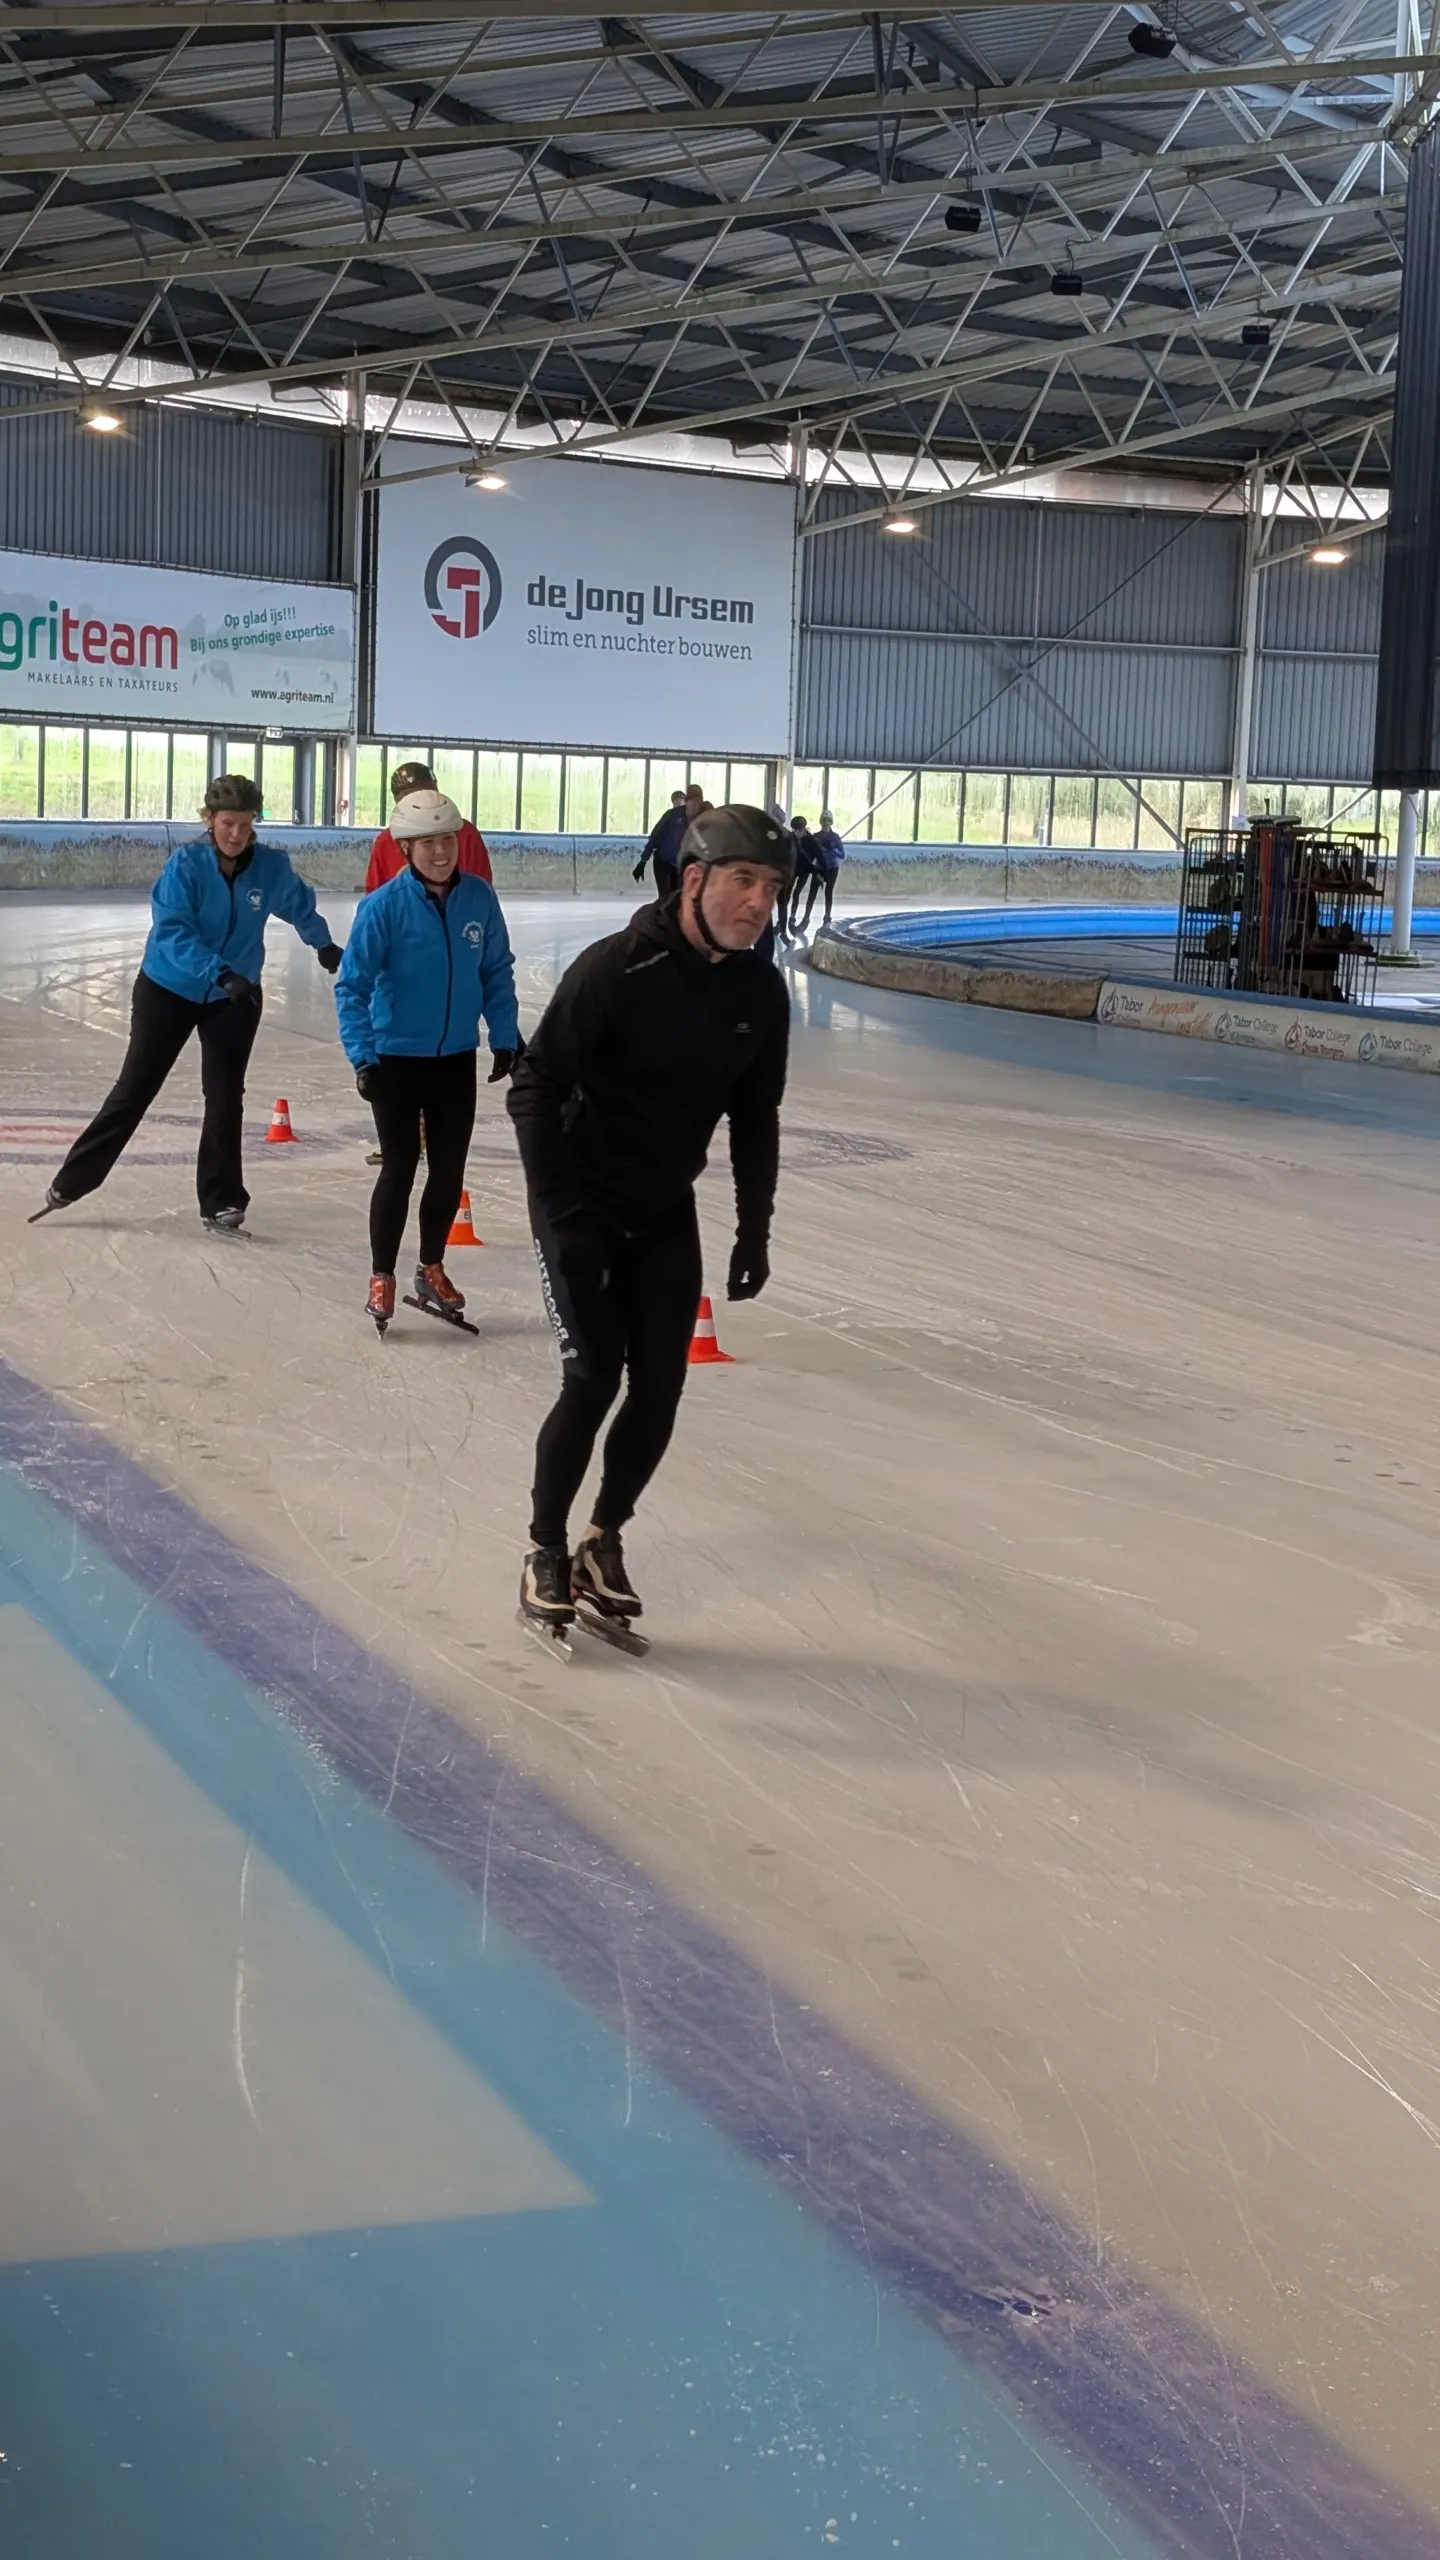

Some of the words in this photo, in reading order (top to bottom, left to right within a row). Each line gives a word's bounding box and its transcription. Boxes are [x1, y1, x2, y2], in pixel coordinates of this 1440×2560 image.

[653, 585, 754, 624] Ursem
[224, 613, 240, 630] Op
[243, 609, 267, 628] glad
[270, 606, 296, 625] ijs!!!
[190, 637, 205, 654] Bij
[208, 638, 229, 650] ons
[231, 630, 282, 651] grondige
[284, 623, 335, 643] expertise
[527, 625, 569, 647] slim
[573, 633, 597, 650] en
[600, 632, 676, 655] nuchter
[679, 636, 752, 661] bouwen
[28, 671, 94, 687] MAKELAARS
[99, 677, 113, 688] EN
[118, 677, 178, 693] TAXATEURS
[251, 688, 334, 704] www.agriteam.nl
[1120, 995, 1144, 1013] Tabor
[1233, 1015, 1253, 1029] Tabor
[1304, 1024, 1325, 1040] Tabor
[1380, 1035, 1402, 1050] Tabor
